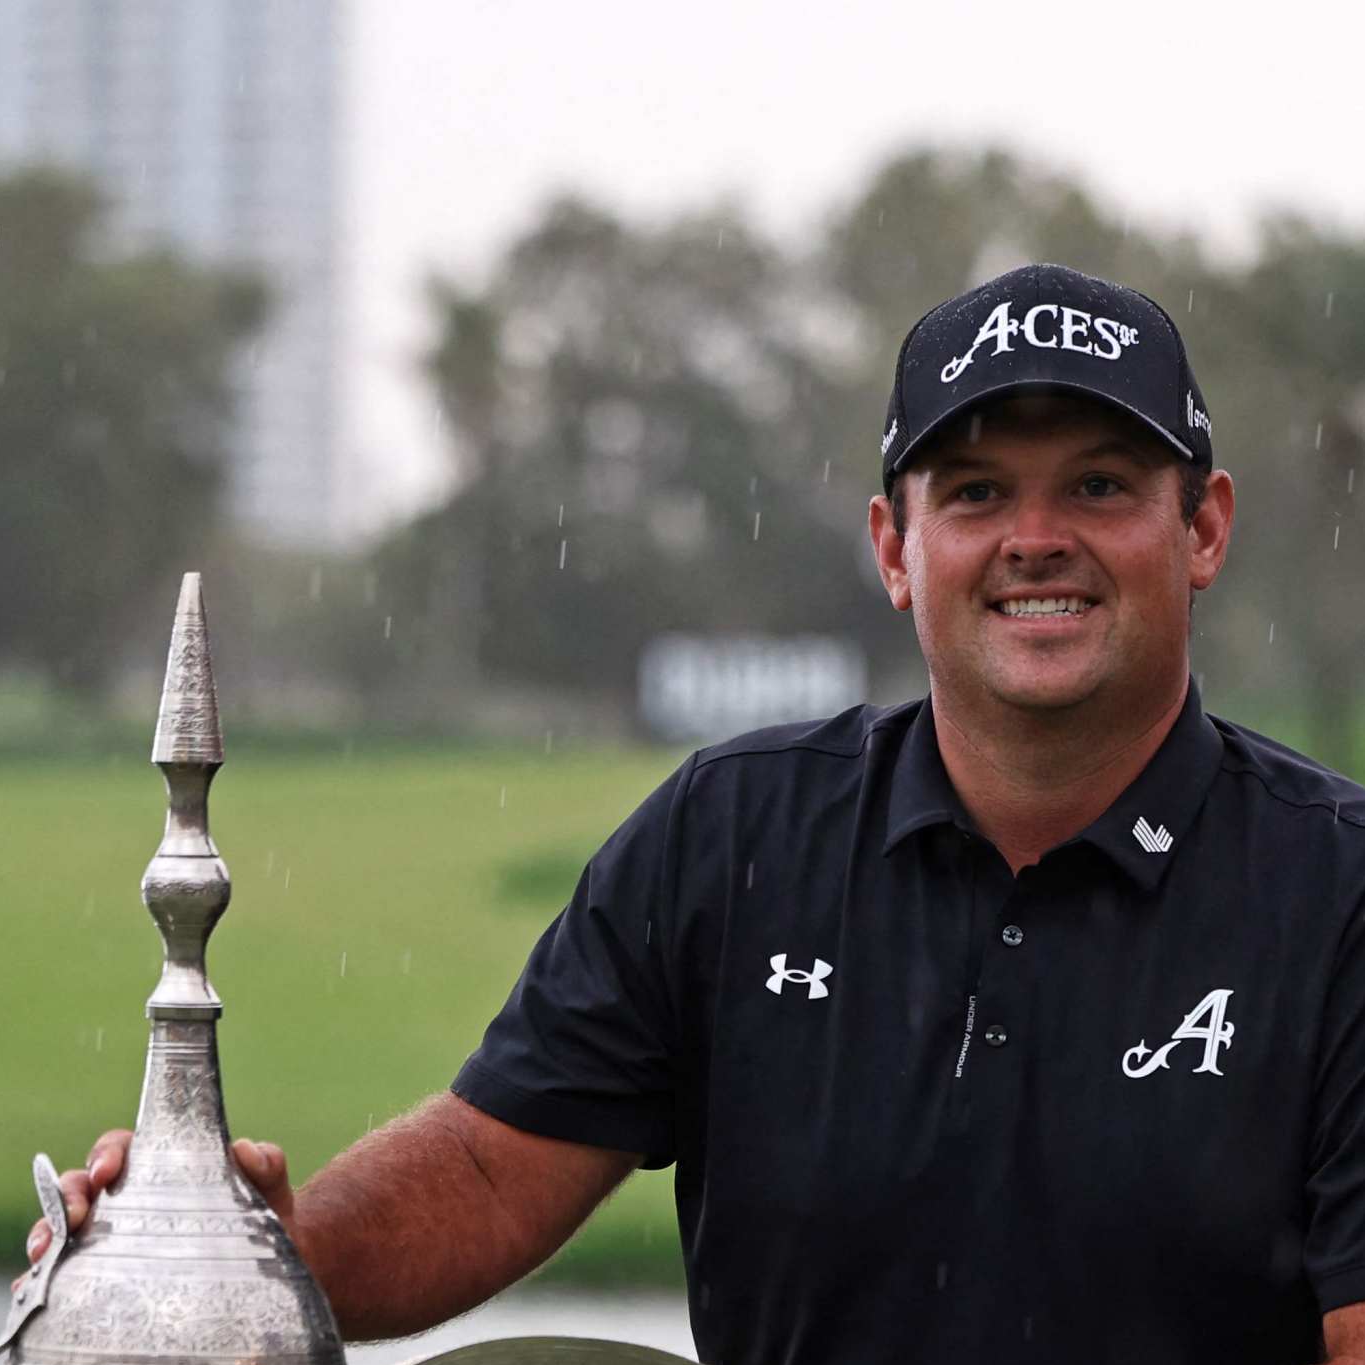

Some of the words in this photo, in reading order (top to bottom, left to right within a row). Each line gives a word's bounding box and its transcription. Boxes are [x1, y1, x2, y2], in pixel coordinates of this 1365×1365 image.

[940, 300, 1123, 383] ACES
[965, 995, 976, 1032] UNDER
[954, 1032, 972, 1079] ARMOUR
